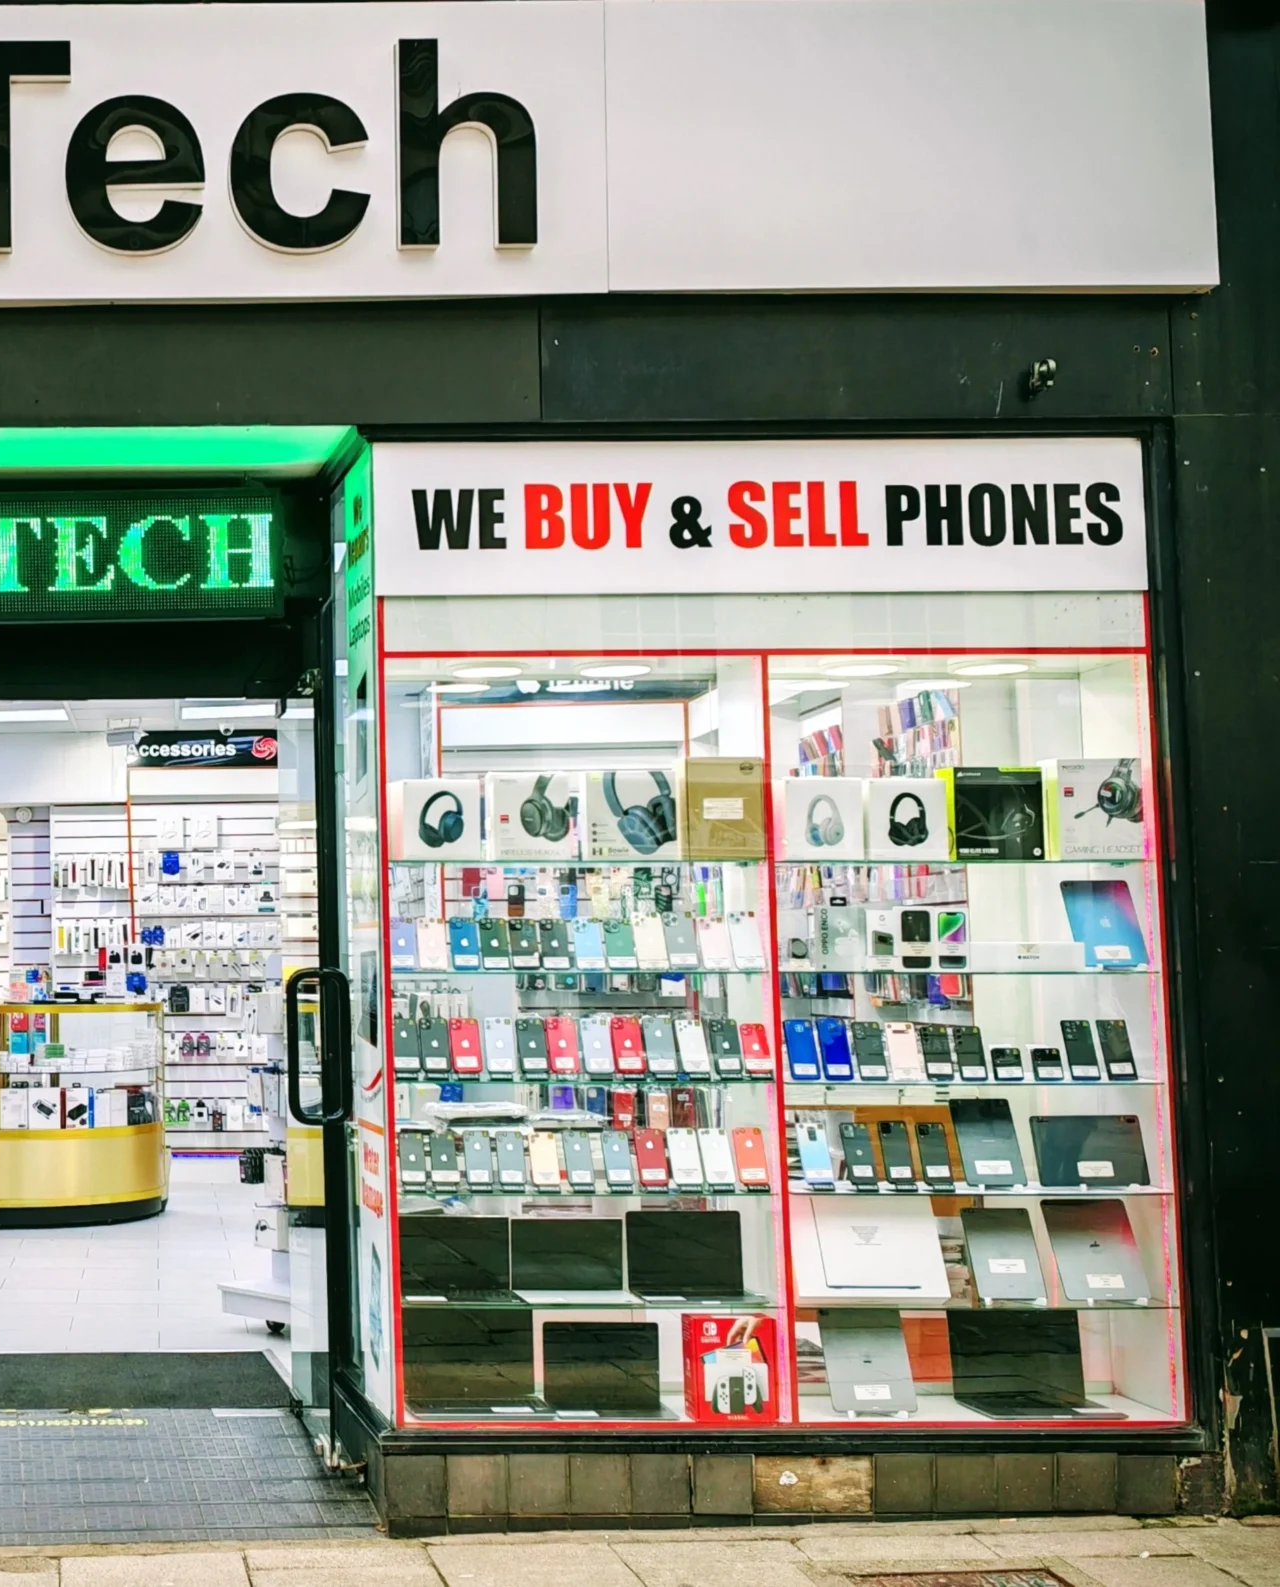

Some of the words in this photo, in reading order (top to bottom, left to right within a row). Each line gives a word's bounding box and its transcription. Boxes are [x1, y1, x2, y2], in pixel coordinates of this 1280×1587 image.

[411, 488, 507, 551] WE
[523, 482, 653, 551] BUY
[669, 496, 712, 549] &
[727, 480, 870, 549] SELL
[884, 482, 1124, 548] PHONES
[348, 576, 370, 611] Mobiles
[348, 614, 371, 650] Laptops
[127, 739, 237, 758] Accessories
[363, 1143, 380, 1176] Water
[362, 1178, 383, 1219] Damage
